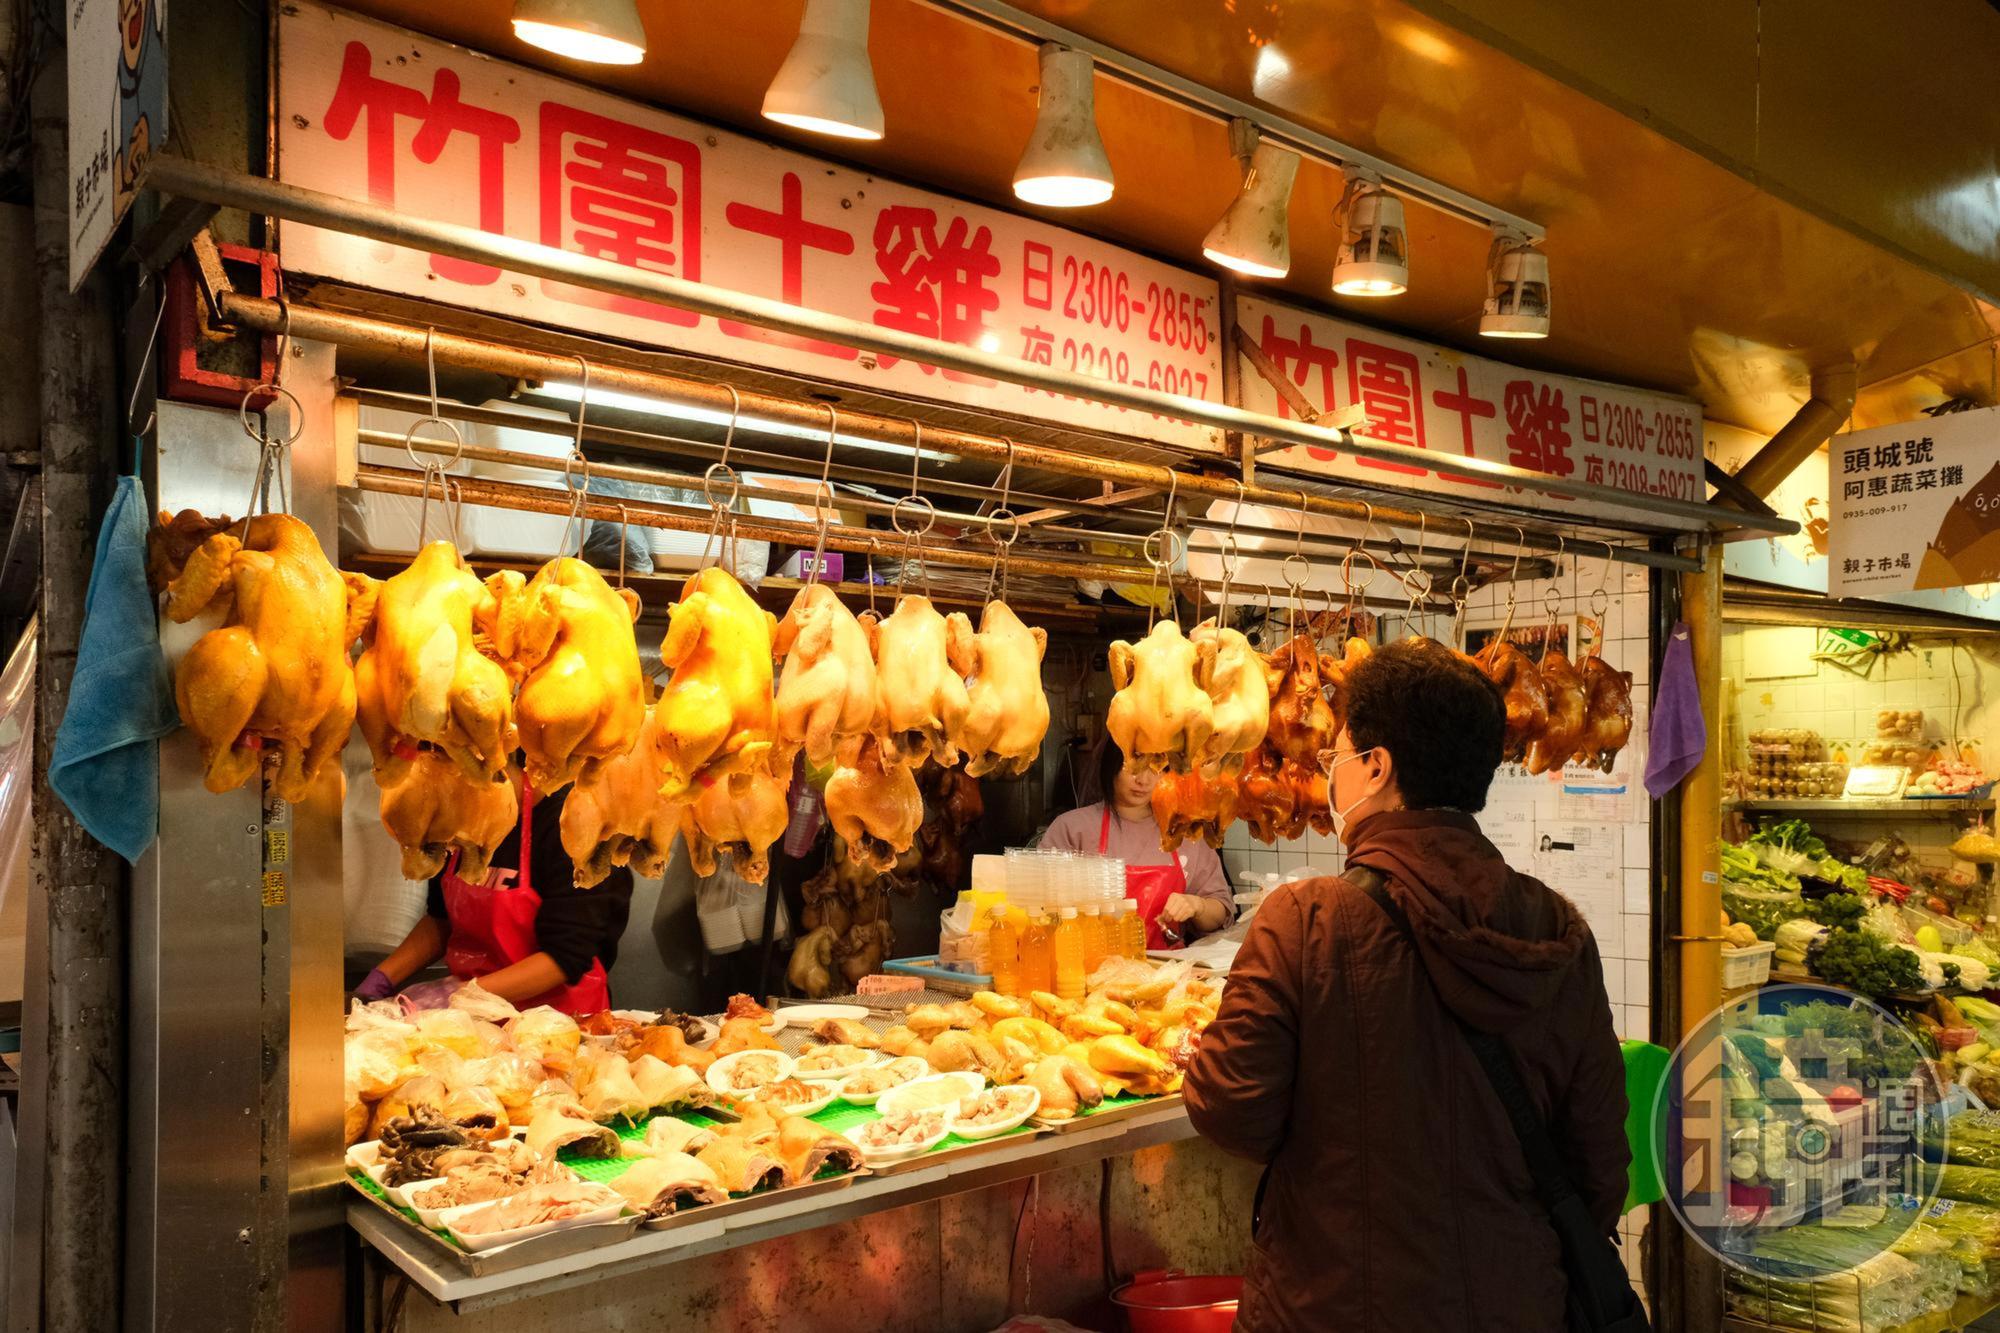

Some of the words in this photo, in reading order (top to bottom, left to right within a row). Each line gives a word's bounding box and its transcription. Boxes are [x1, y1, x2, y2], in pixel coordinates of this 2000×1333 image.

[1843, 437, 1934, 474] 頭城號
[1844, 464, 1964, 501] 阿惠蔬菜攤
[1842, 504, 1908, 519] 0935-009-917
[1842, 553, 1911, 574] 親子市場
